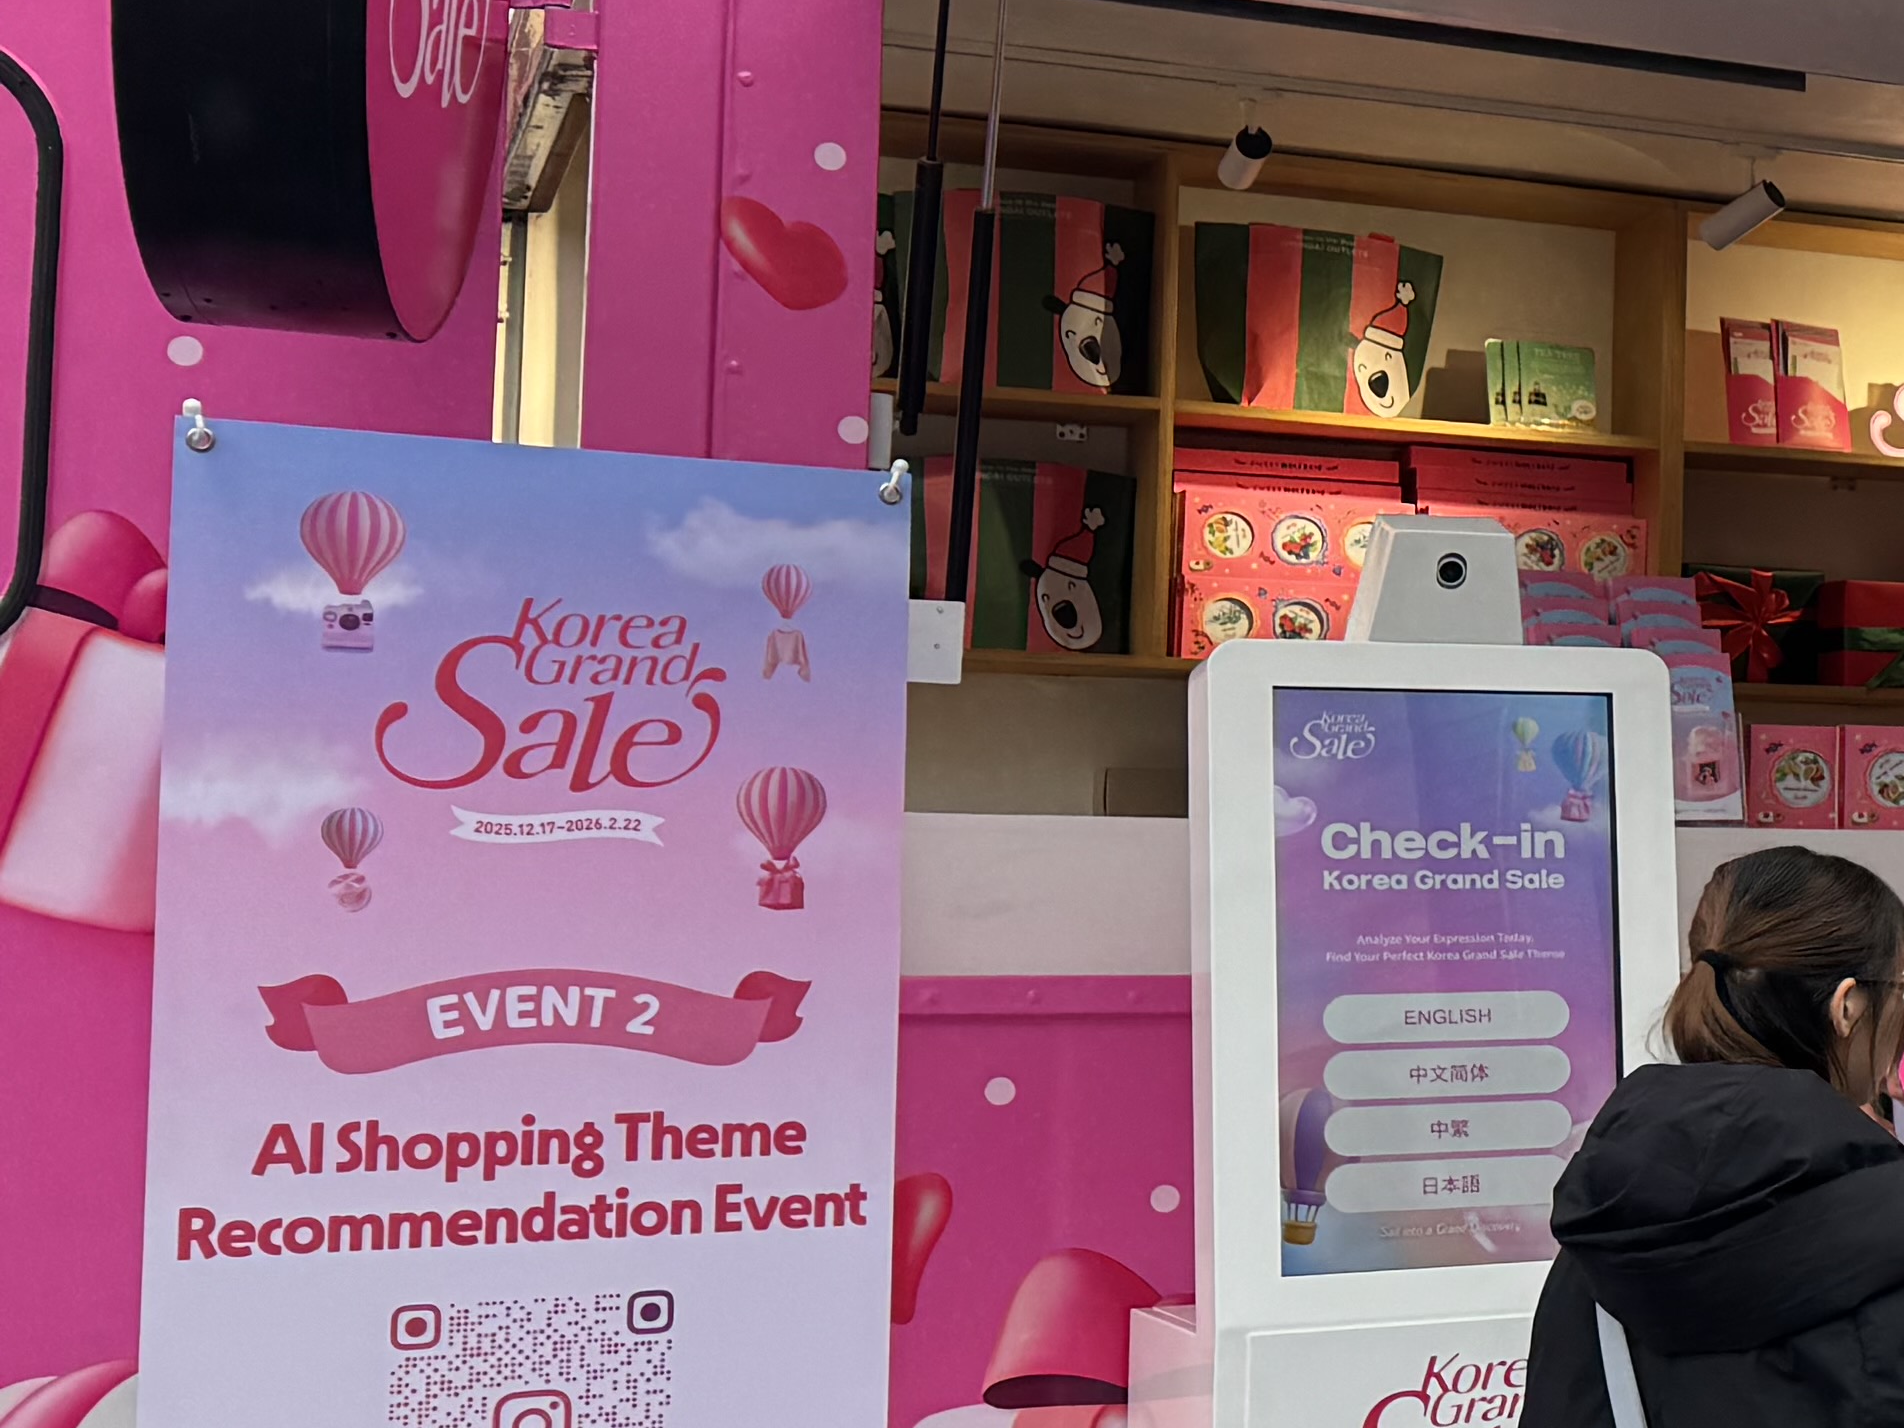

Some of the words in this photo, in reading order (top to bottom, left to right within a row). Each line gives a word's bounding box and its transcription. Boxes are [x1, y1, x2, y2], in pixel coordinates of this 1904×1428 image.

[511, 597, 688, 649] Korea
[523, 641, 701, 686] Grand
[375, 634, 728, 793] Sale
[1319, 710, 1366, 725] Korea
[1289, 719, 1376, 760] Sale
[1320, 821, 1566, 861] Check-in
[1322, 869, 1409, 891] Korea
[1413, 868, 1500, 891] Grand
[1504, 868, 1566, 890] Sale
[1325, 951, 1352, 963] Find
[1353, 952, 1380, 962] Your
[1382, 951, 1425, 962] Perfect
[1426, 950, 1460, 961] Korea
[1462, 949, 1498, 961] Grand
[1500, 948, 1525, 960] Sale
[1356, 933, 1402, 947] Analyze
[1404, 933, 1431, 945] Your
[1432, 932, 1495, 947] Expression
[425, 985, 616, 1040] EVENT
[624, 993, 661, 1035] 2
[1403, 1008, 1493, 1026] ENGLISH
[1409, 1063, 1490, 1085] 中文简体
[251, 1122, 324, 1176] AI
[335, 1113, 605, 1183] Shopping
[614, 1110, 807, 1162] Theme
[1422, 1174, 1481, 1195] 日本語
[176, 1186, 702, 1261] Recommendation
[713, 1182, 868, 1234] Event
[1420, 1353, 1529, 1394] Kore
[1429, 1390, 1523, 1428] Gra
